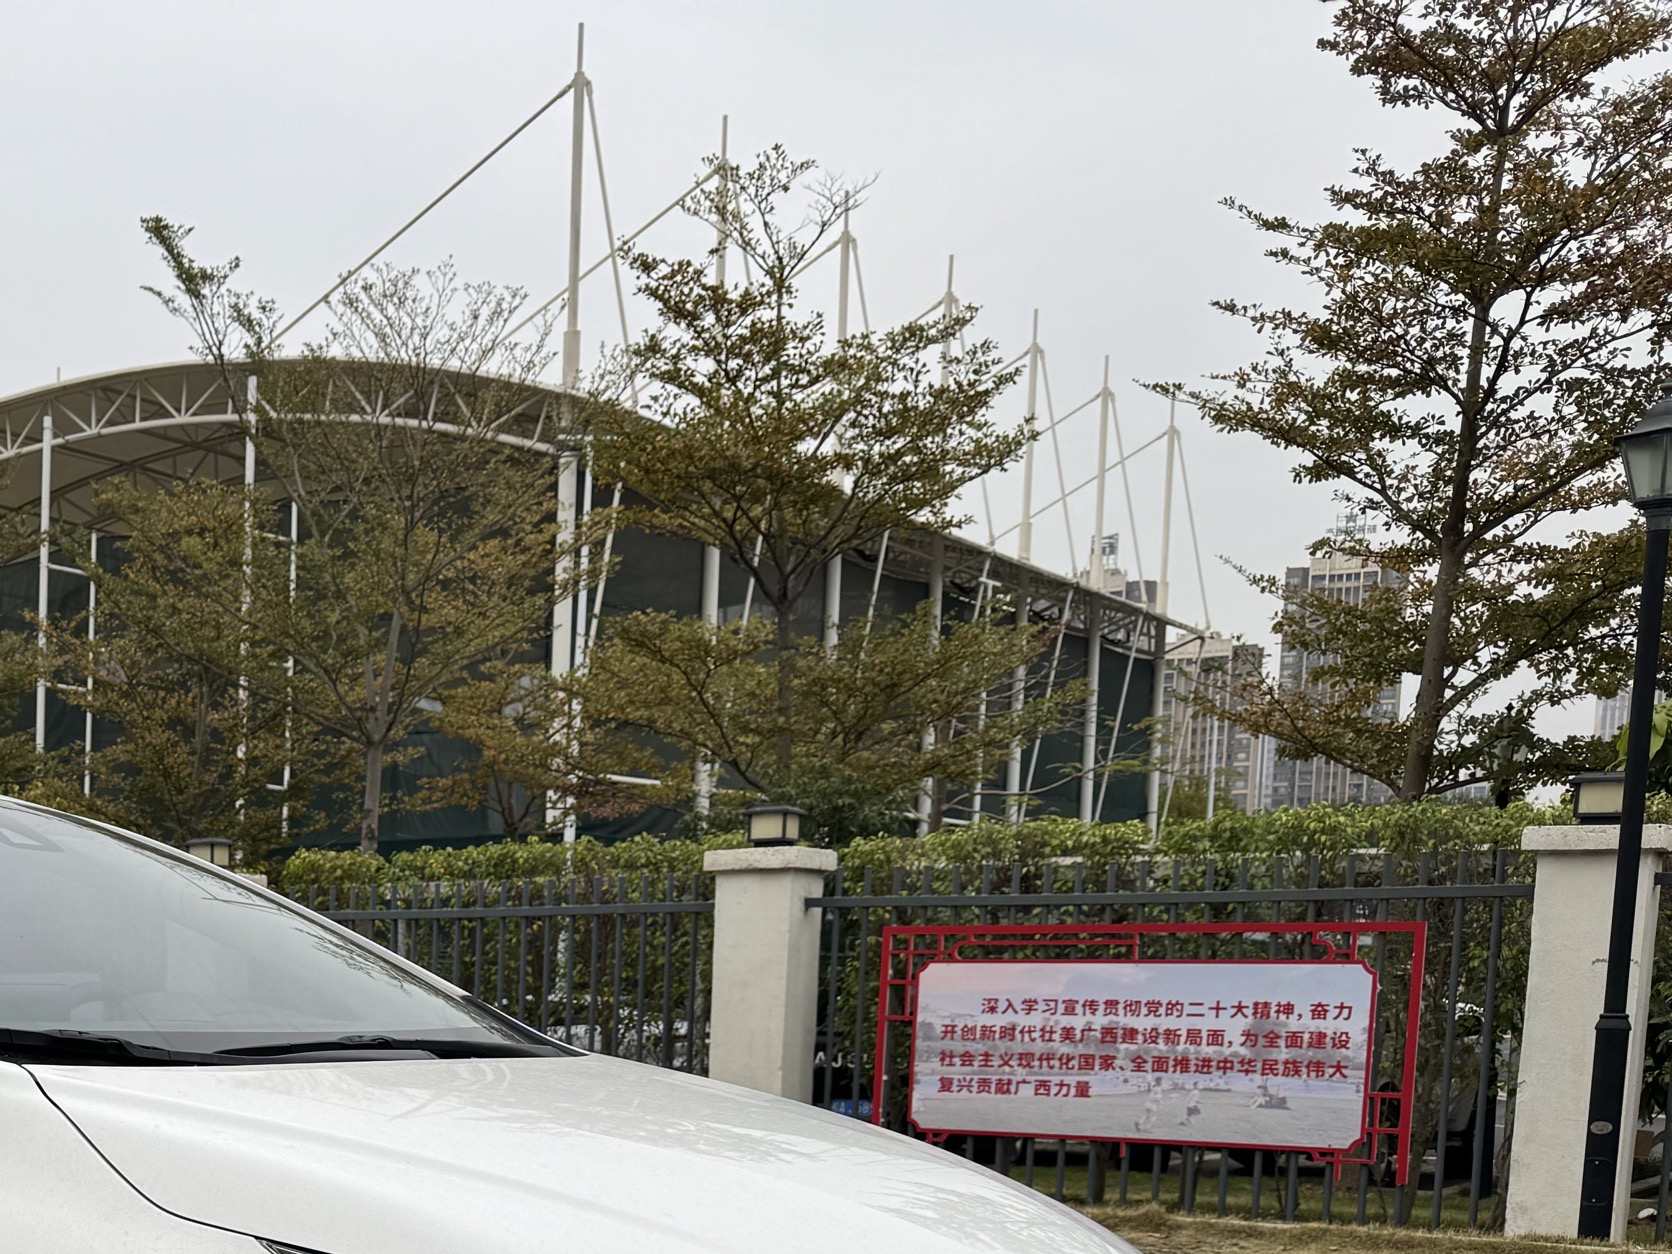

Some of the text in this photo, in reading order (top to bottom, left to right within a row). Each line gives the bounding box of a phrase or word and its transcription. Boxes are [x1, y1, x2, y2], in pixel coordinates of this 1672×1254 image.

[980, 997, 1353, 1021] 深入学习宣传贯彻党的二十大精神，奋力
[940, 1024, 1352, 1050] 开创新时代壮美广西建设新局面，为全面建设
[939, 1049, 1349, 1079] 社会主义现代化国家、全面推进中华民族伟大
[937, 1076, 1093, 1099] 复兴贡献广西力量
